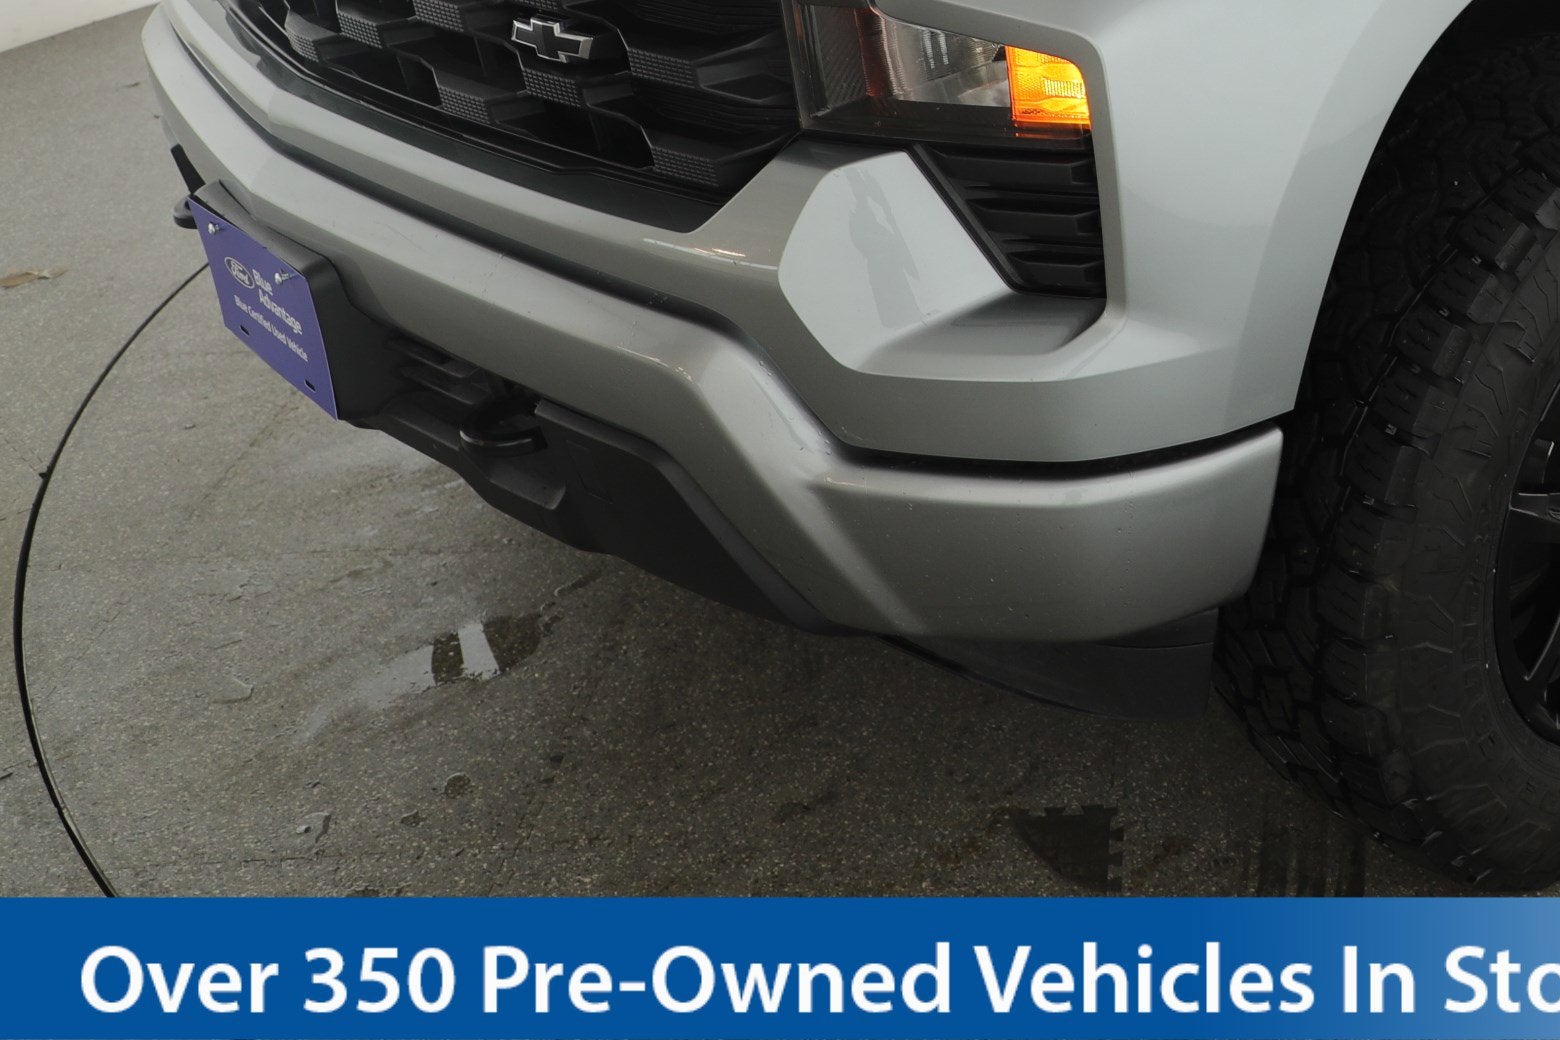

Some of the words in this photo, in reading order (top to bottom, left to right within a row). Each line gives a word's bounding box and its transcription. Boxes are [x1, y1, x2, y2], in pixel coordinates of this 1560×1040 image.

[252, 269, 274, 296] Blue
[233, 294, 249, 314] Blue
[247, 305, 273, 333] Certified
[270, 323, 288, 345] Used
[285, 336, 309, 362] Vehicle
[258, 289, 303, 336] Advantage
